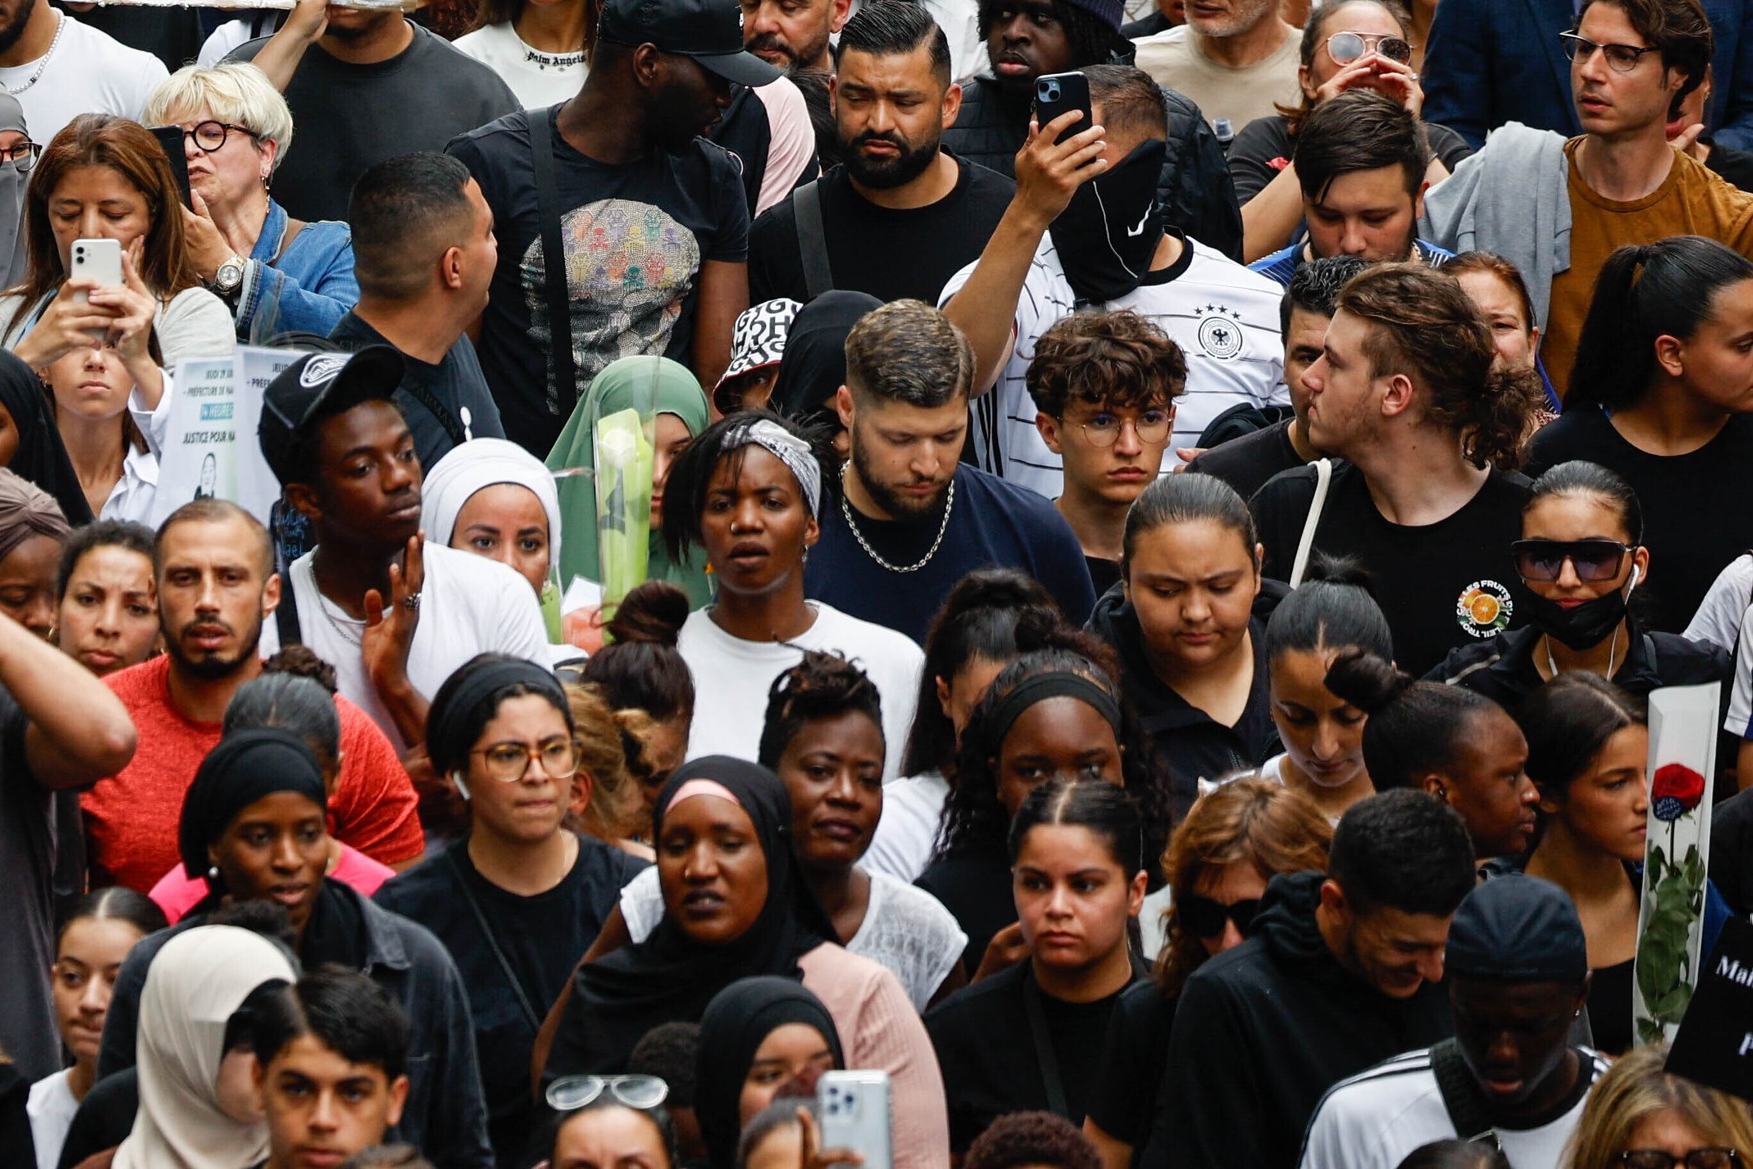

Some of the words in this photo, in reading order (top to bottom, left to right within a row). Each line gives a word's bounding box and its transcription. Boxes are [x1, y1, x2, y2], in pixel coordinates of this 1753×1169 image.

[527, 51, 550, 65] Palm
[552, 54, 586, 67] Angels
[183, 431, 209, 444] JUSTICE
[1480, 580, 1511, 601] FRUITS
